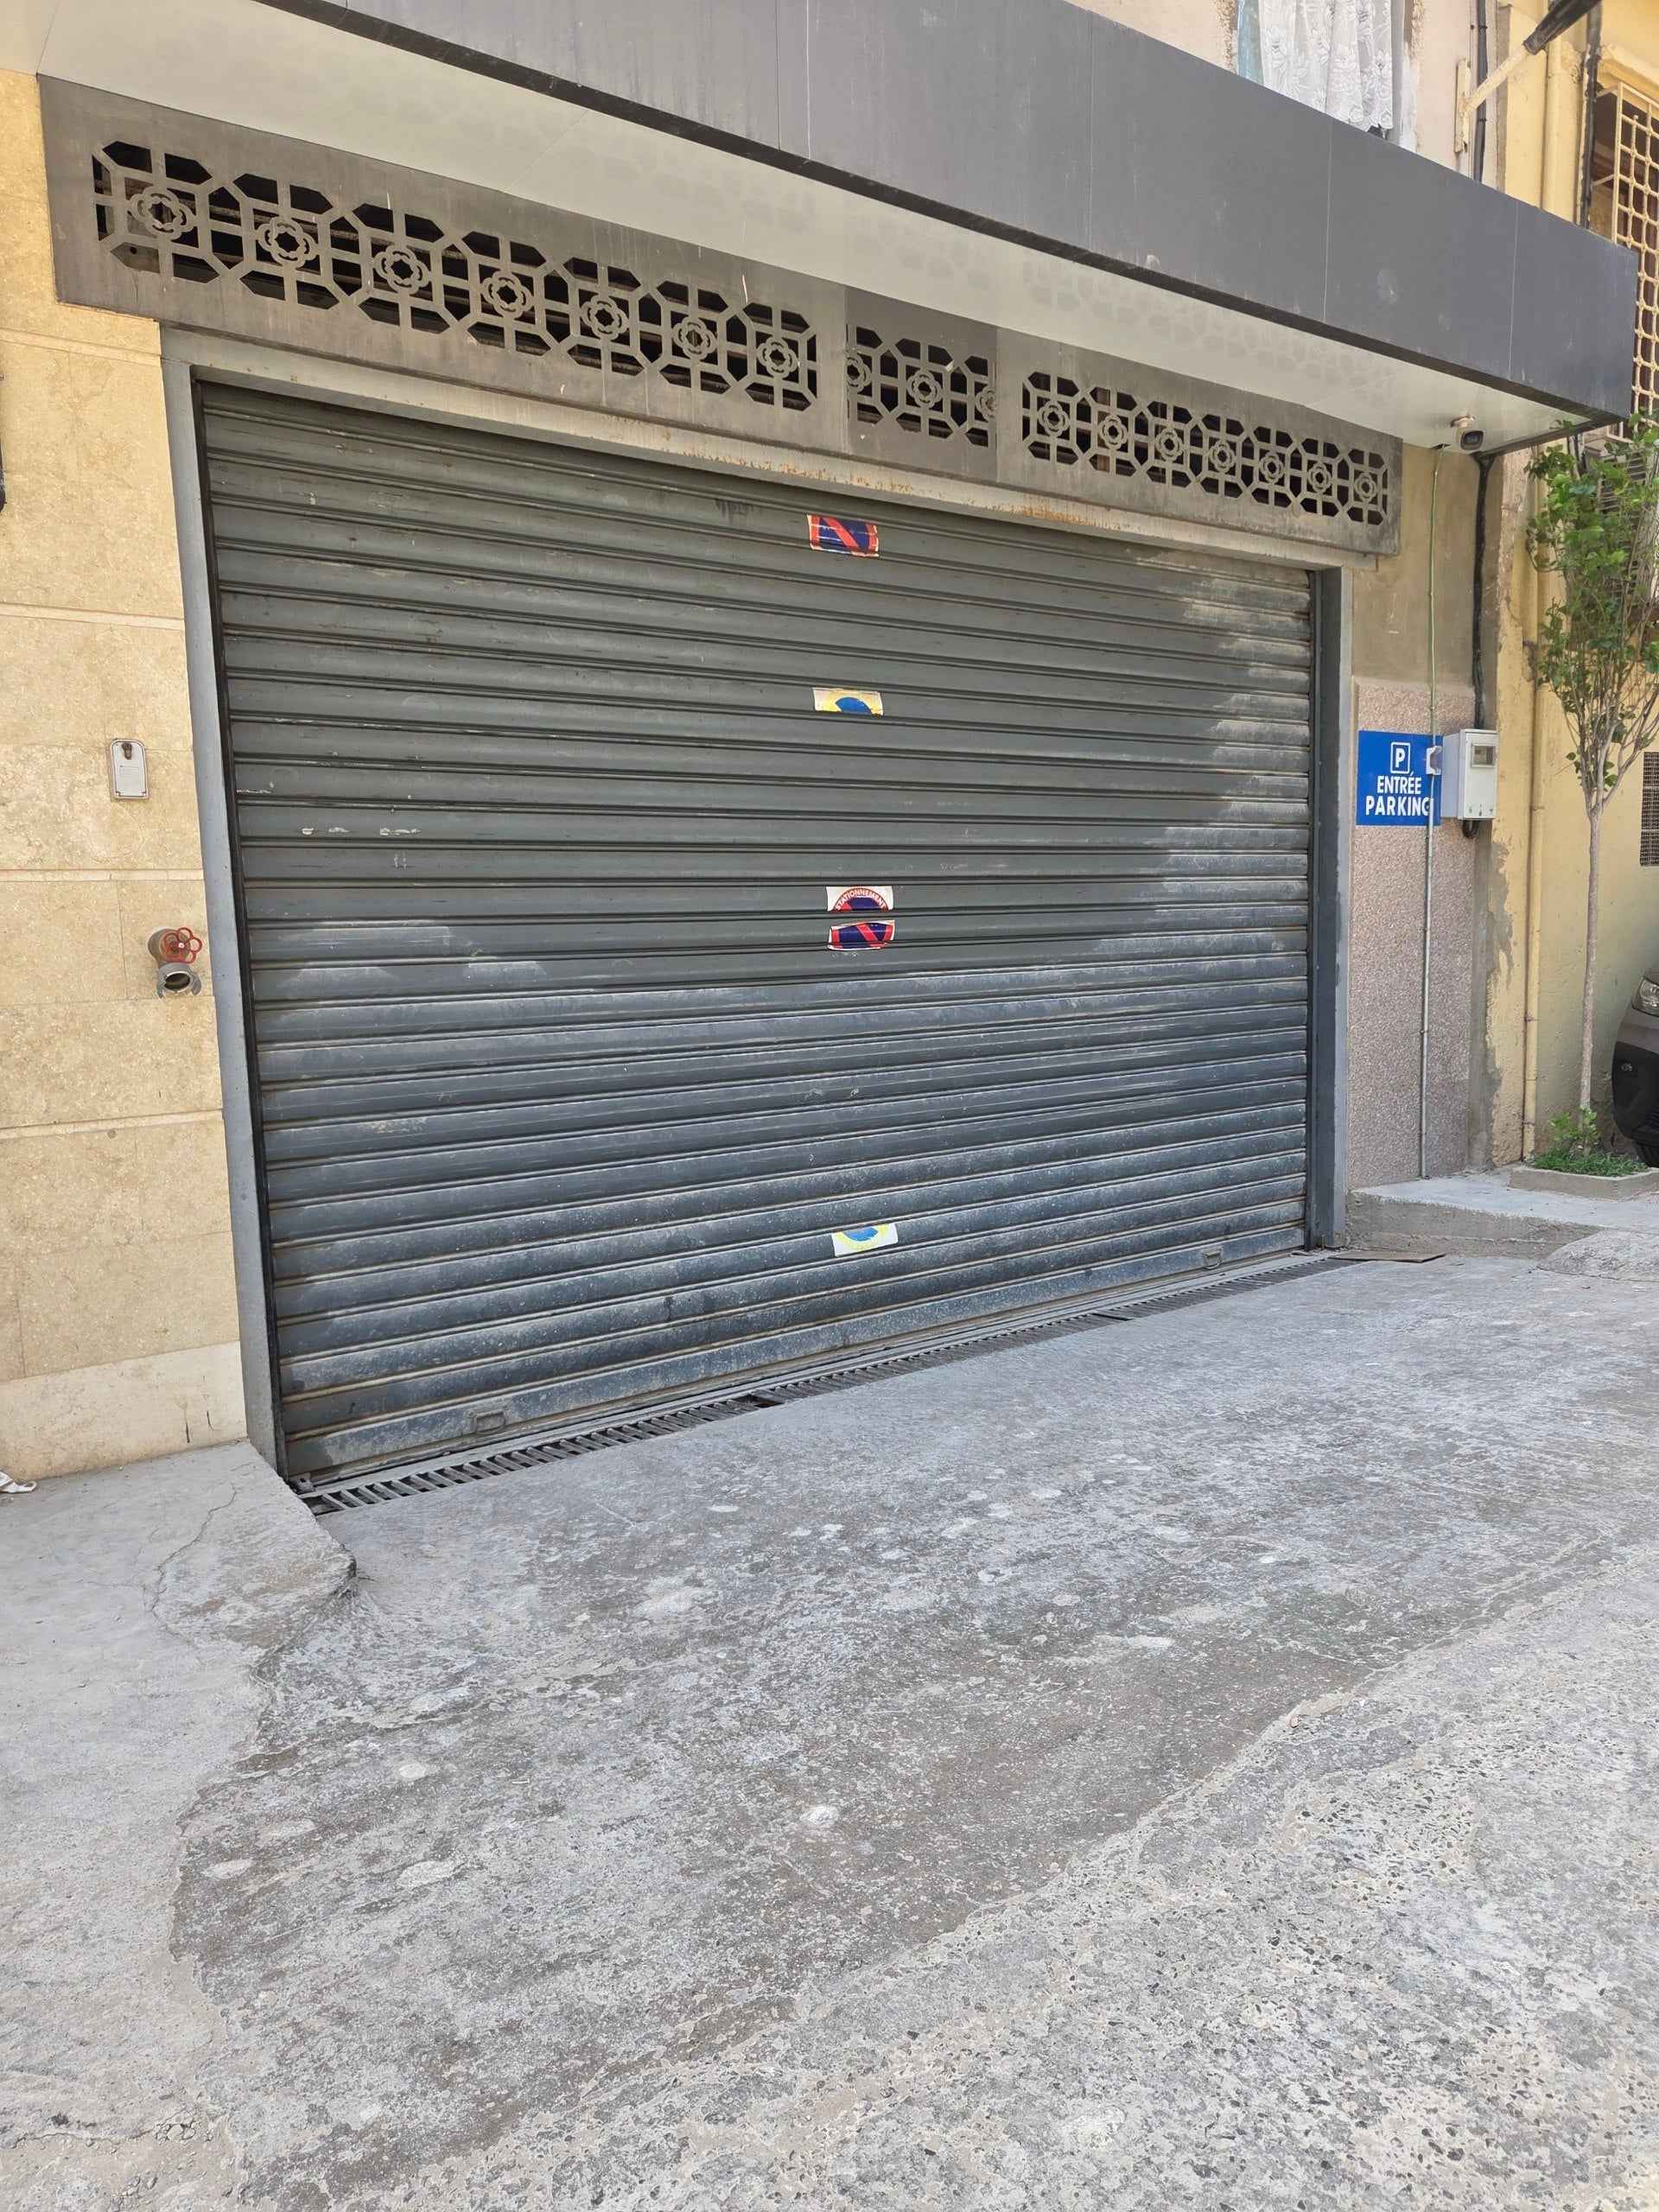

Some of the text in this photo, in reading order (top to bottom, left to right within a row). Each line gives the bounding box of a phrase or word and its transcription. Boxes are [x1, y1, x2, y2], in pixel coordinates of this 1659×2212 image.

[1395, 747, 1406, 768] P
[1376, 772, 1422, 794] ENTRÉE
[835, 888, 887, 911] STATIONNEMENT
